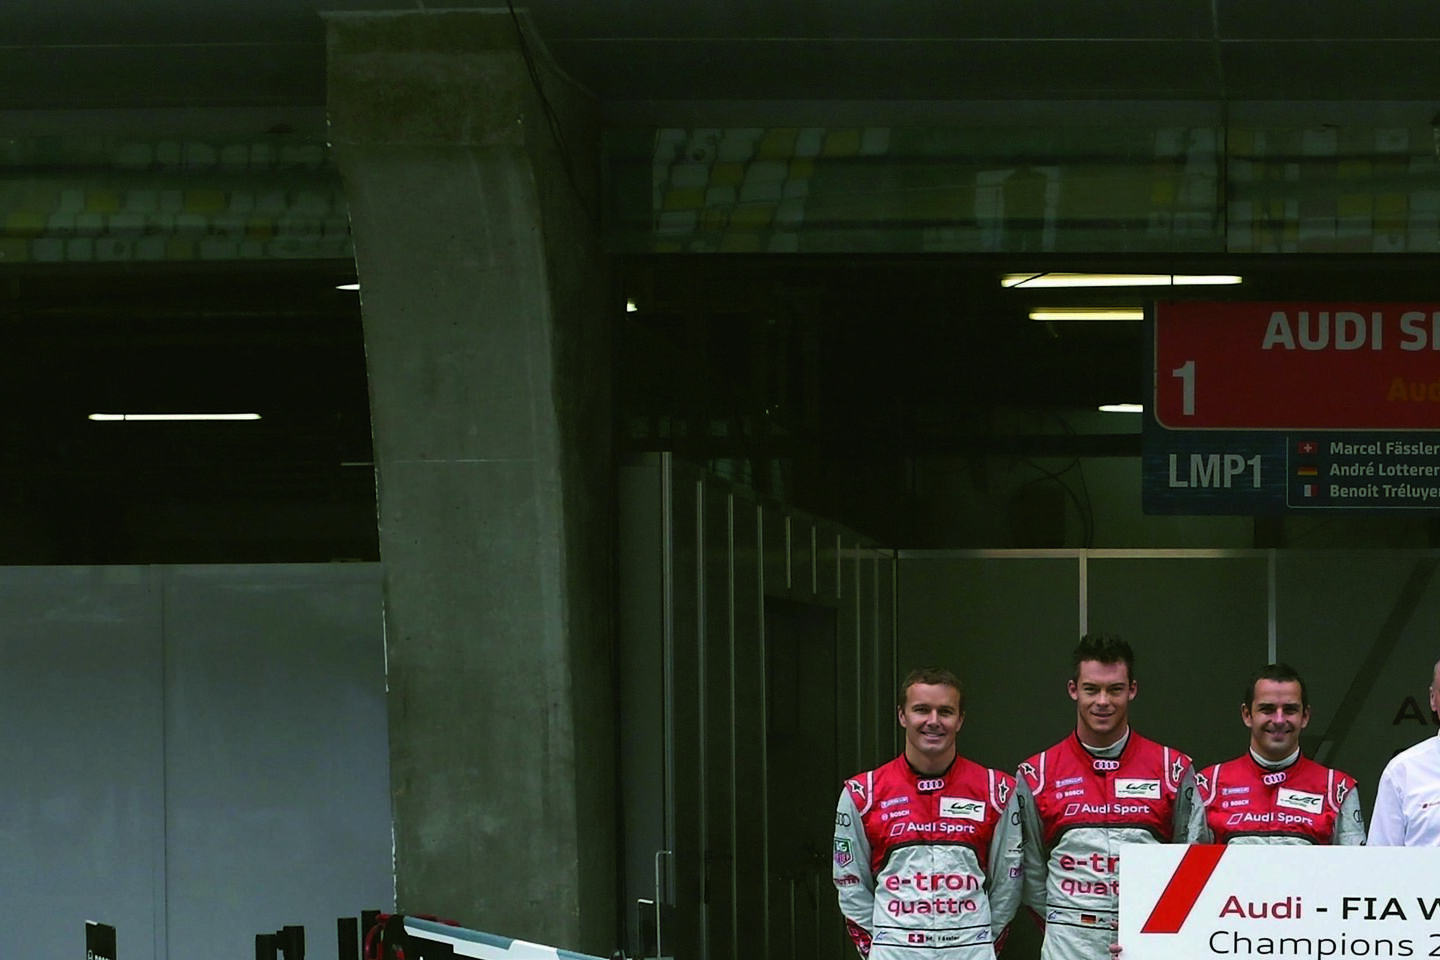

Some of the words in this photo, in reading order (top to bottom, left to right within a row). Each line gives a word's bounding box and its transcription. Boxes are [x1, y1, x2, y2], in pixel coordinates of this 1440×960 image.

[1261, 311, 1383, 350] AUDI
[1172, 360, 1196, 416] 1
[1329, 441, 1381, 455] Marcel
[1384, 440, 1440, 455] Fässler
[1168, 453, 1261, 488] LMP1
[1329, 462, 1375, 476] André
[1378, 463, 1440, 476] Lotterer
[1329, 484, 1379, 498] Benoit
[1081, 804, 1110, 813] Audi
[1113, 804, 1149, 815] Sport
[1243, 812, 1274, 822] Audi
[1277, 812, 1313, 825] Sport
[907, 822, 936, 832] Audi
[939, 823, 975, 834] Sport
[1059, 853, 1119, 873] e-tr
[885, 872, 979, 891] e-tron
[1061, 879, 1119, 896] quat
[887, 898, 977, 917] quattro
[1218, 895, 1302, 919] Audi
[1342, 897, 1407, 920] FIA
[1209, 930, 1413, 960] Champions
